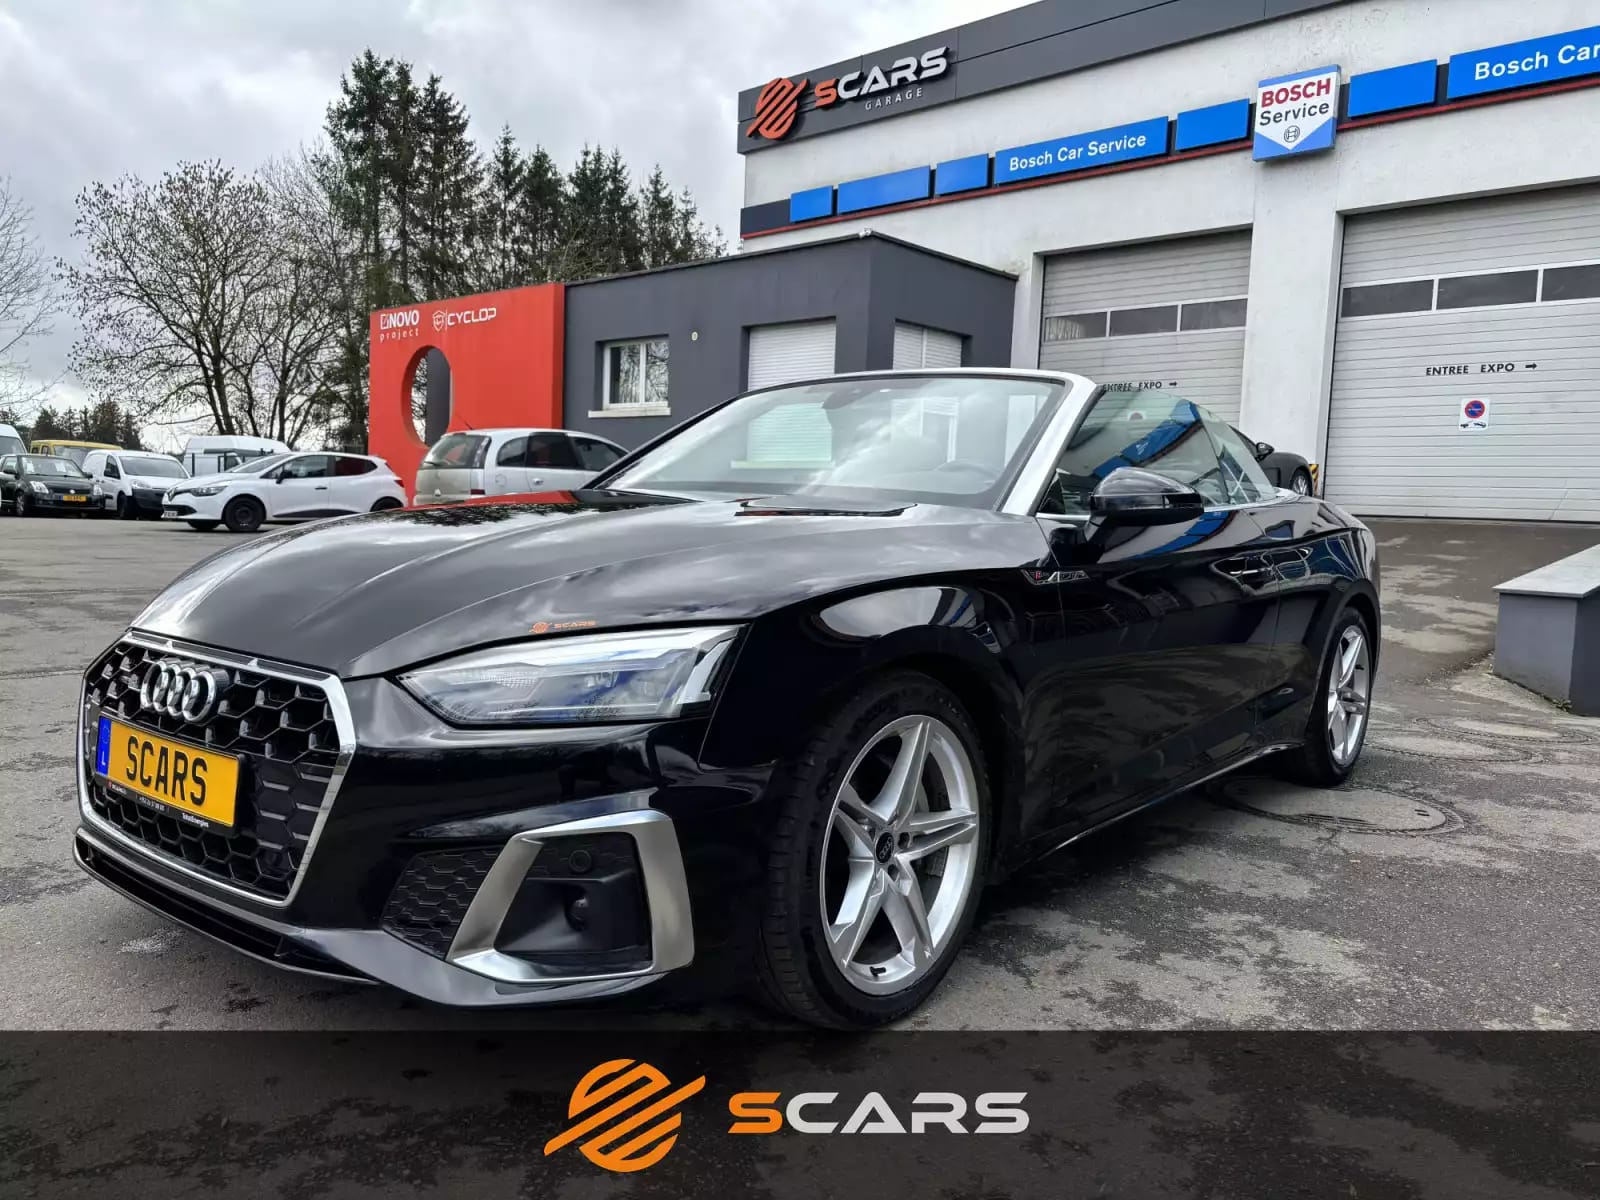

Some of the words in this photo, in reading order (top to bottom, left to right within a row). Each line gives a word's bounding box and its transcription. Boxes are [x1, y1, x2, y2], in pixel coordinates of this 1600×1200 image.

[814, 46, 950, 109] SCARS
[1475, 51, 1549, 81] Bosch
[865, 87, 924, 111] GARAGE
[1260, 77, 1331, 108] BOSCH
[1259, 102, 1330, 127] Service
[1008, 150, 1054, 172] Bosch
[1056, 143, 1085, 162] Car
[1087, 133, 1147, 158] Service
[447, 307, 497, 326] CYCLOP
[379, 328, 419, 343] project
[1425, 365, 1470, 377] ENTREE
[1480, 362, 1515, 374] EXPO
[1138, 381, 1162, 392] EXPO
[125, 735, 208, 807] SCARS
